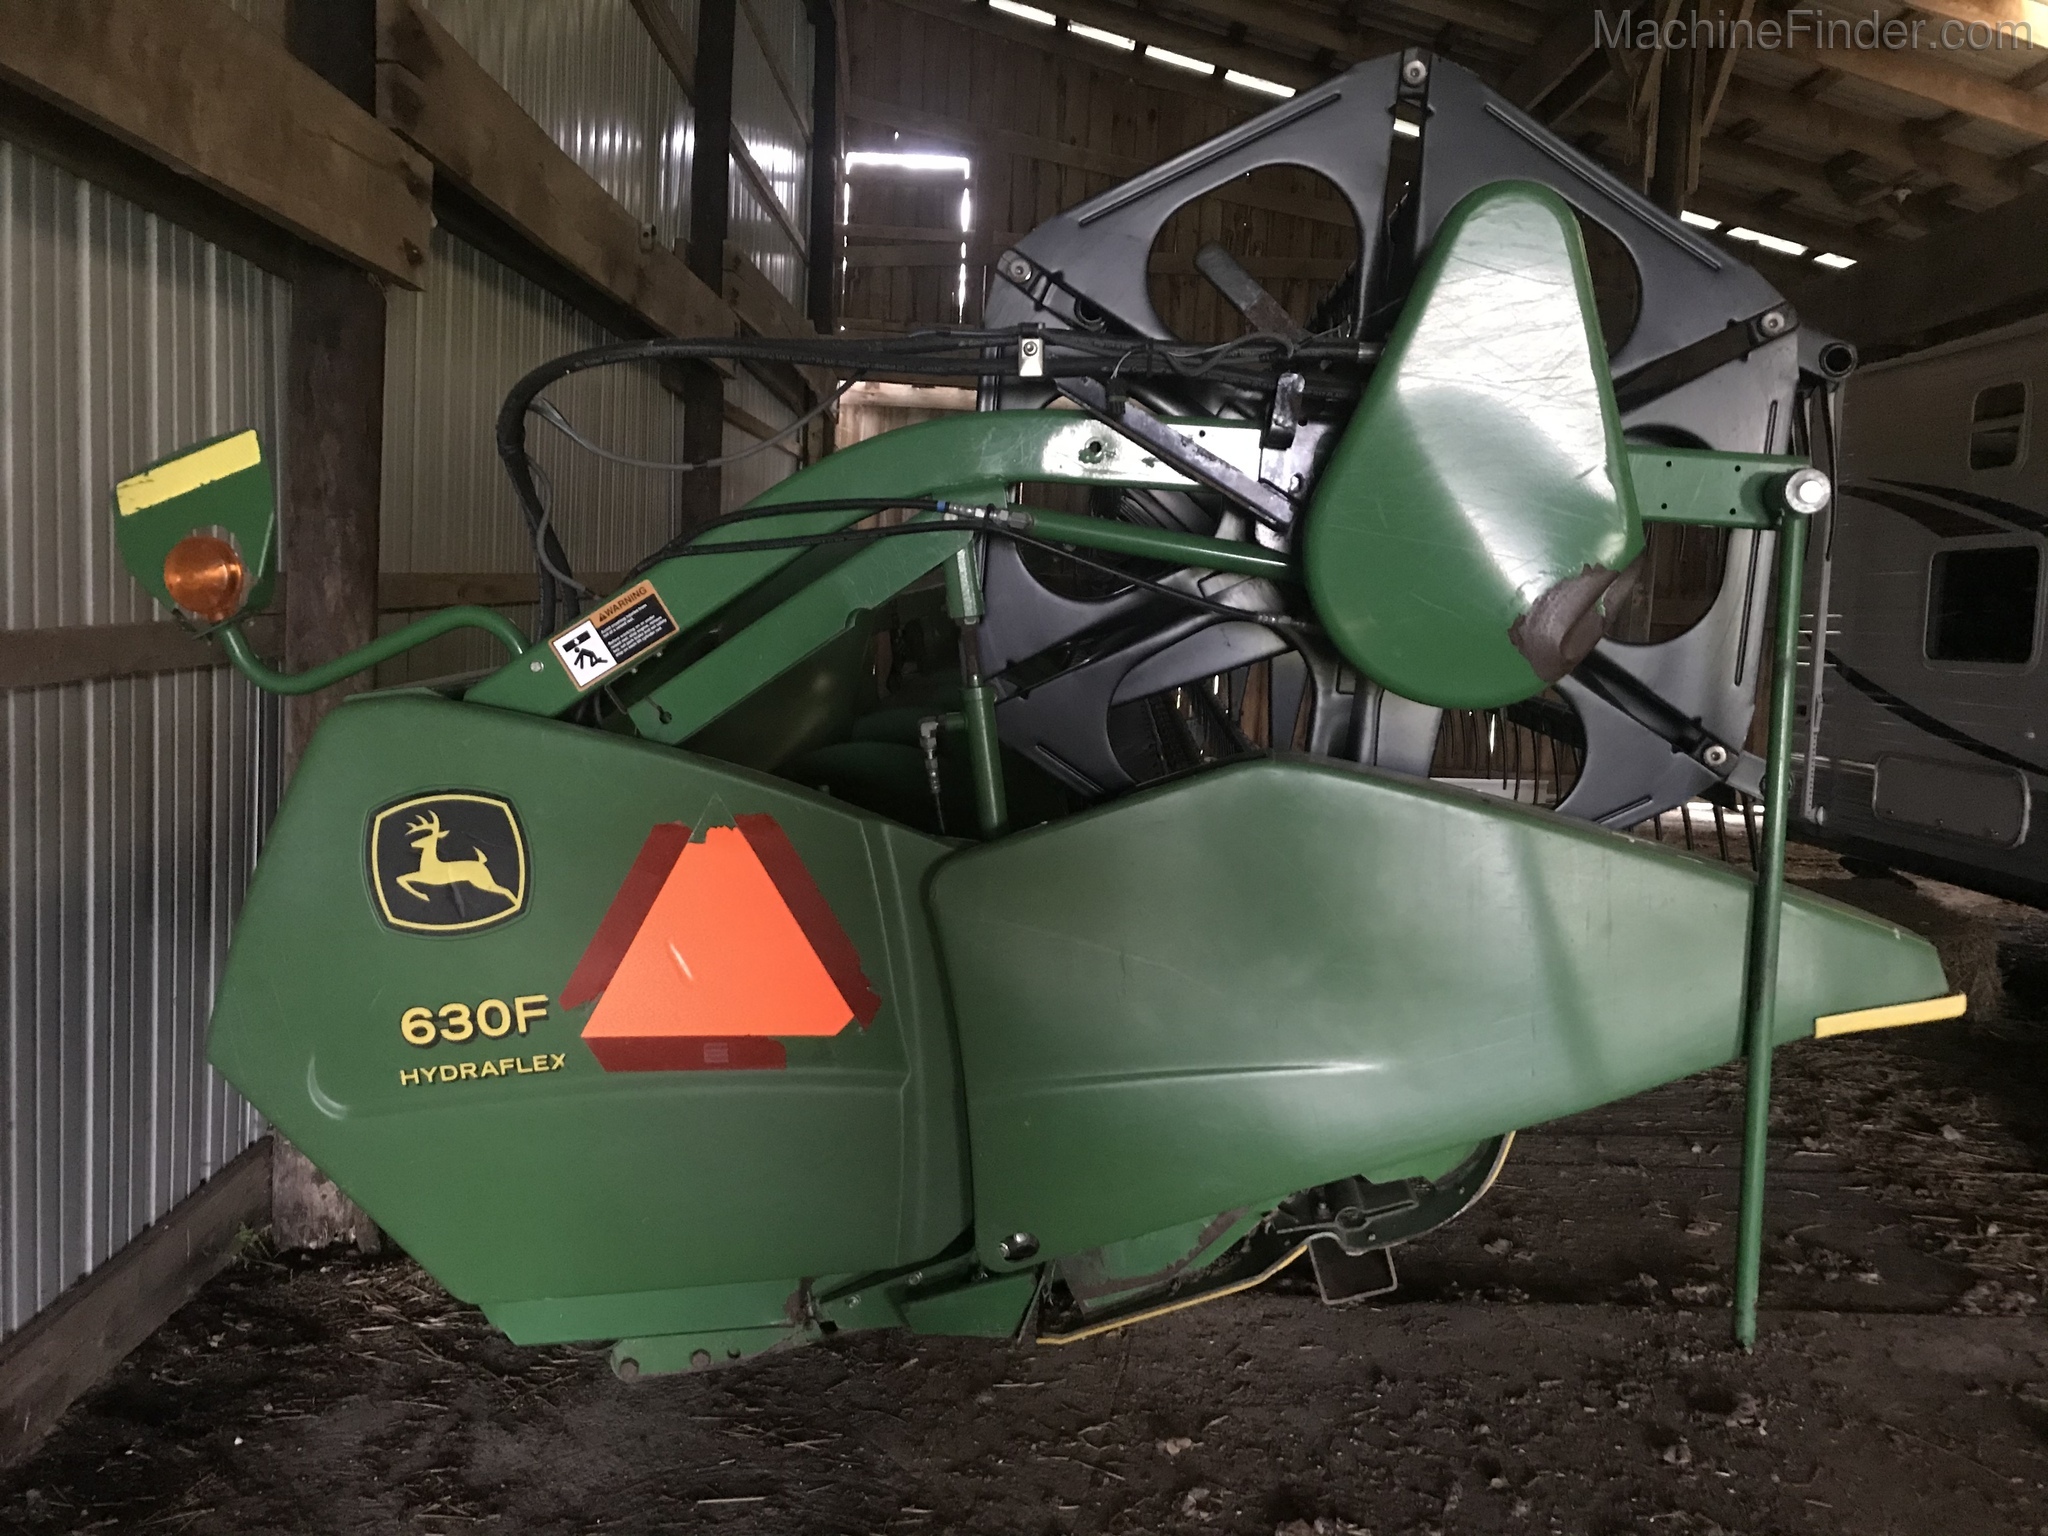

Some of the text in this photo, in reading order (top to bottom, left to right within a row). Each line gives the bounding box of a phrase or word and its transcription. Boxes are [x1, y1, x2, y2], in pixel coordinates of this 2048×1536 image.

[603, 586, 648, 618] WARNING
[400, 994, 549, 1047] 630F
[400, 1053, 567, 1086] HYDRAFLEX
